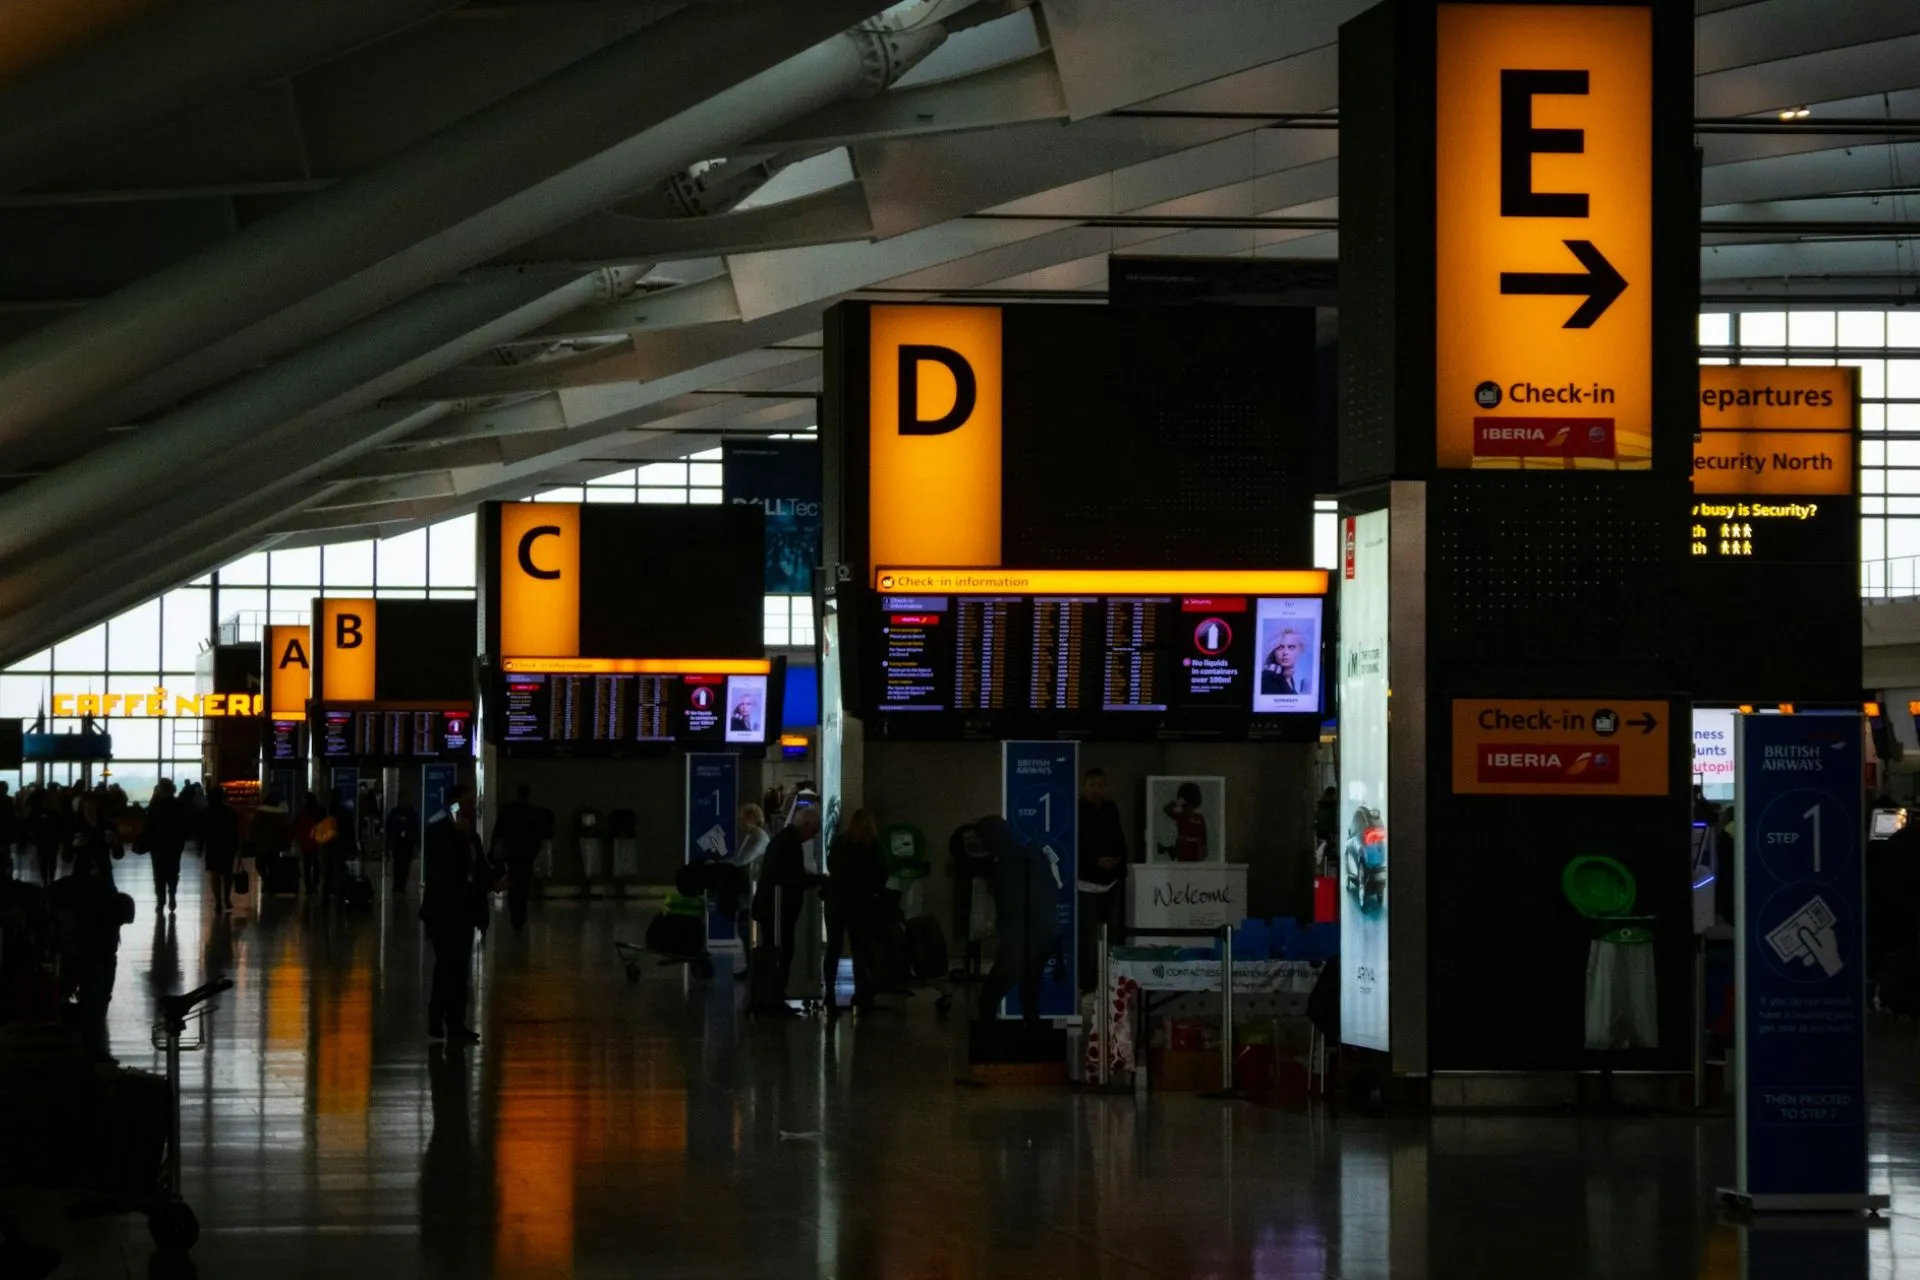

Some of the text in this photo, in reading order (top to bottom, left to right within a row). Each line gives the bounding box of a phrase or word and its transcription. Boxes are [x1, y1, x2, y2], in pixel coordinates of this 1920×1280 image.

[1501, 70, 1590, 216] E
[899, 346, 976, 435] D
[1509, 382, 1615, 404] Check-in
[1701, 386, 1833, 412] epartures
[1482, 428, 1545, 440] IBERIA
[1693, 452, 1833, 474] ecurity North
[1701, 503, 1736, 519] busy
[1738, 503, 1750, 516] is
[1752, 503, 1818, 520] Security?
[518, 526, 561, 580] C
[898, 576, 1029, 588] Check-in information
[337, 614, 363, 649] B
[279, 639, 310, 669] A
[1477, 708, 1586, 731] Check-in
[1694, 731, 1724, 739] ness
[1487, 753, 1562, 767] IBERIA
[1764, 744, 1821, 758] BRITISH
[1761, 758, 1824, 772] AIRWAYS
[711, 788, 720, 816] 1
[1039, 792, 1050, 833] 1
[1766, 803, 1821, 873] STEP 1
[1154, 883, 1232, 907] Welcome
[1763, 1094, 1852, 1105] THEN PROCEED
[1780, 1108, 1798, 1119] TO
[1800, 1108, 1828, 1119] STEP
